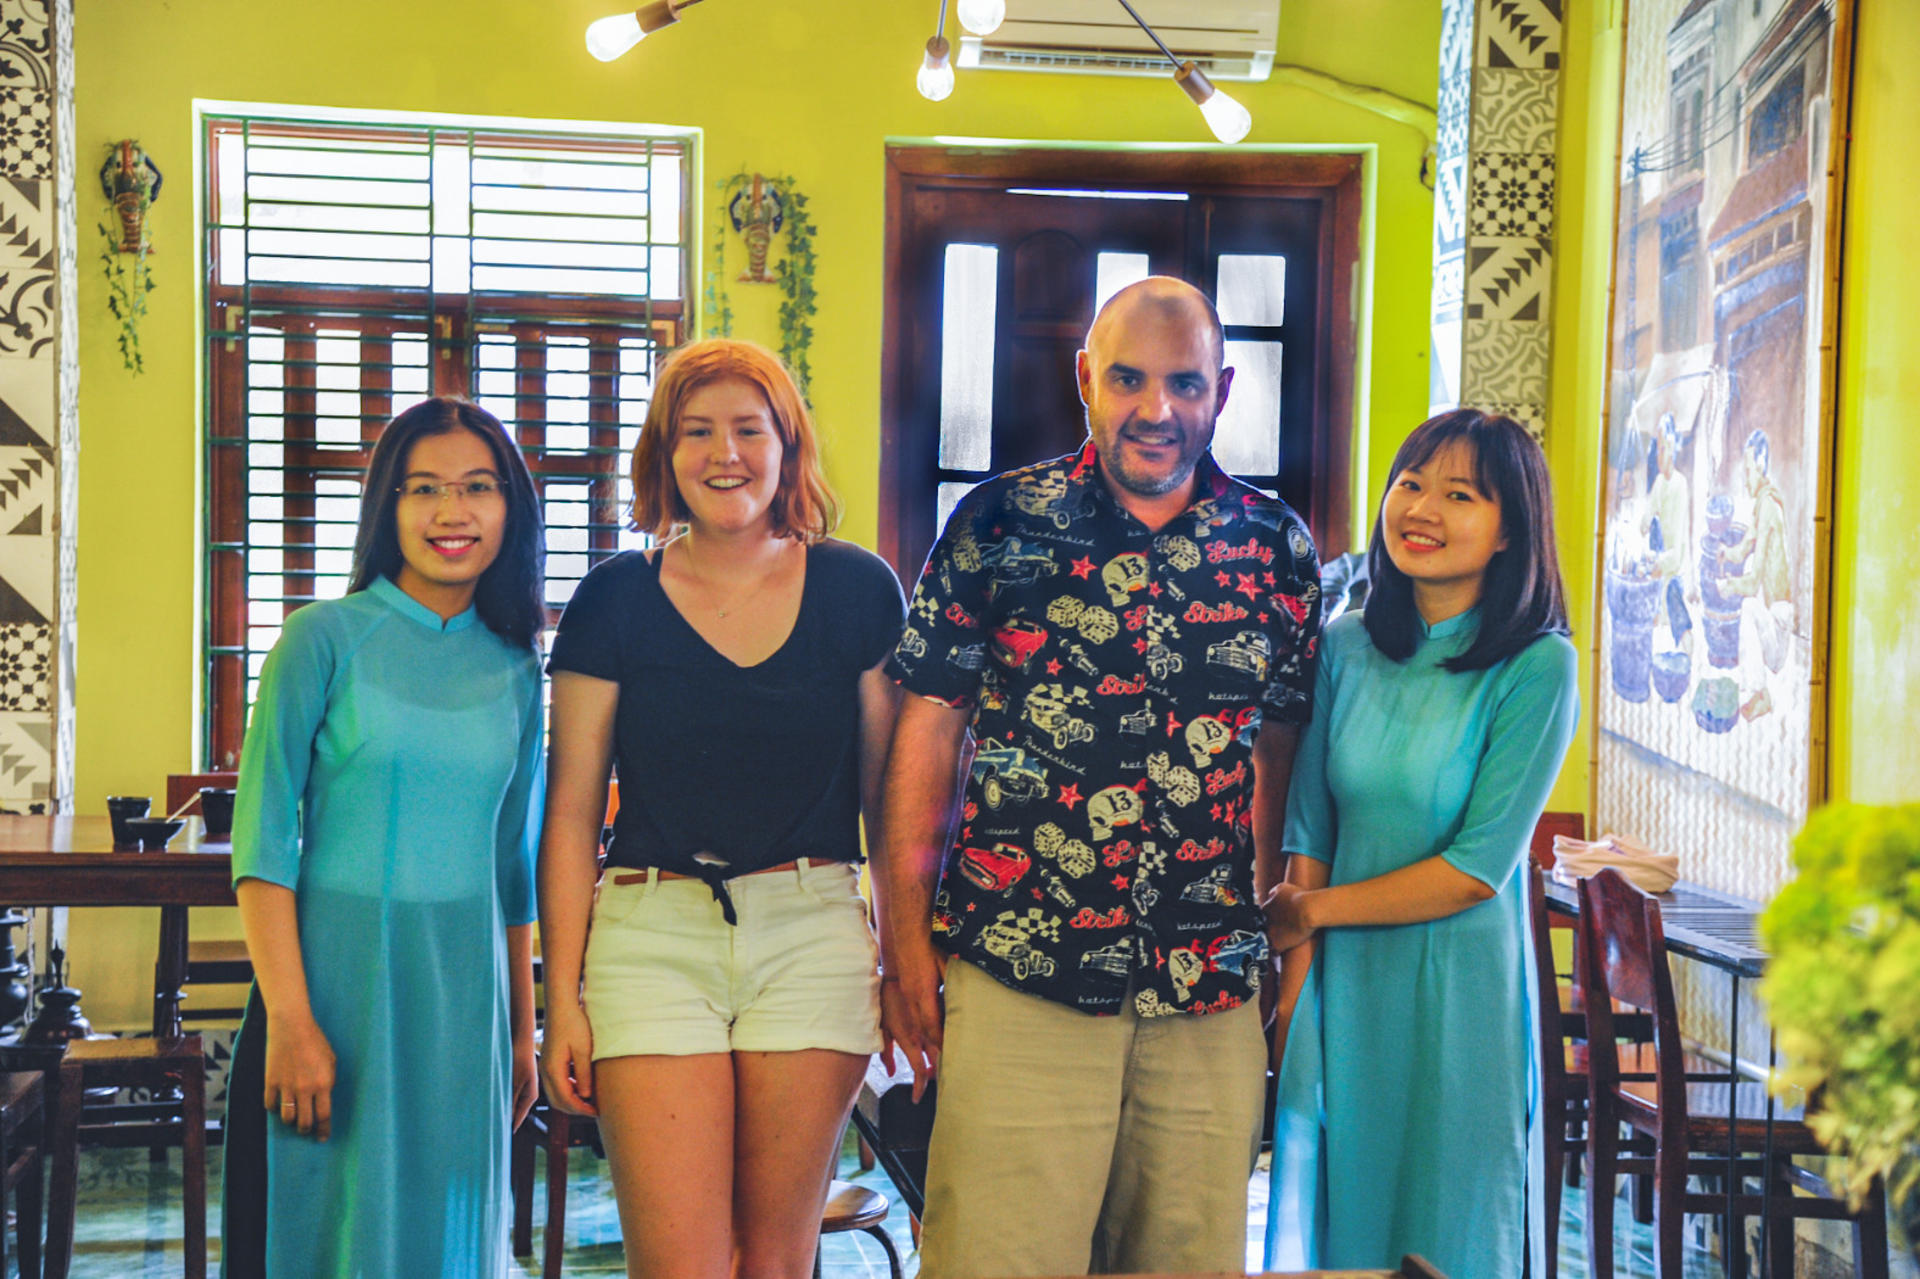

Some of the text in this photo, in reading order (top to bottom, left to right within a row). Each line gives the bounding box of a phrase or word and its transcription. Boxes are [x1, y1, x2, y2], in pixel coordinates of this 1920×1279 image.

[1205, 537, 1275, 566] Lucky
[1117, 557, 1143, 579] 13
[1182, 601, 1248, 624] Strike
[1203, 721, 1222, 740] 13
[1106, 791, 1131, 813] 13
[1174, 953, 1193, 973] 13
